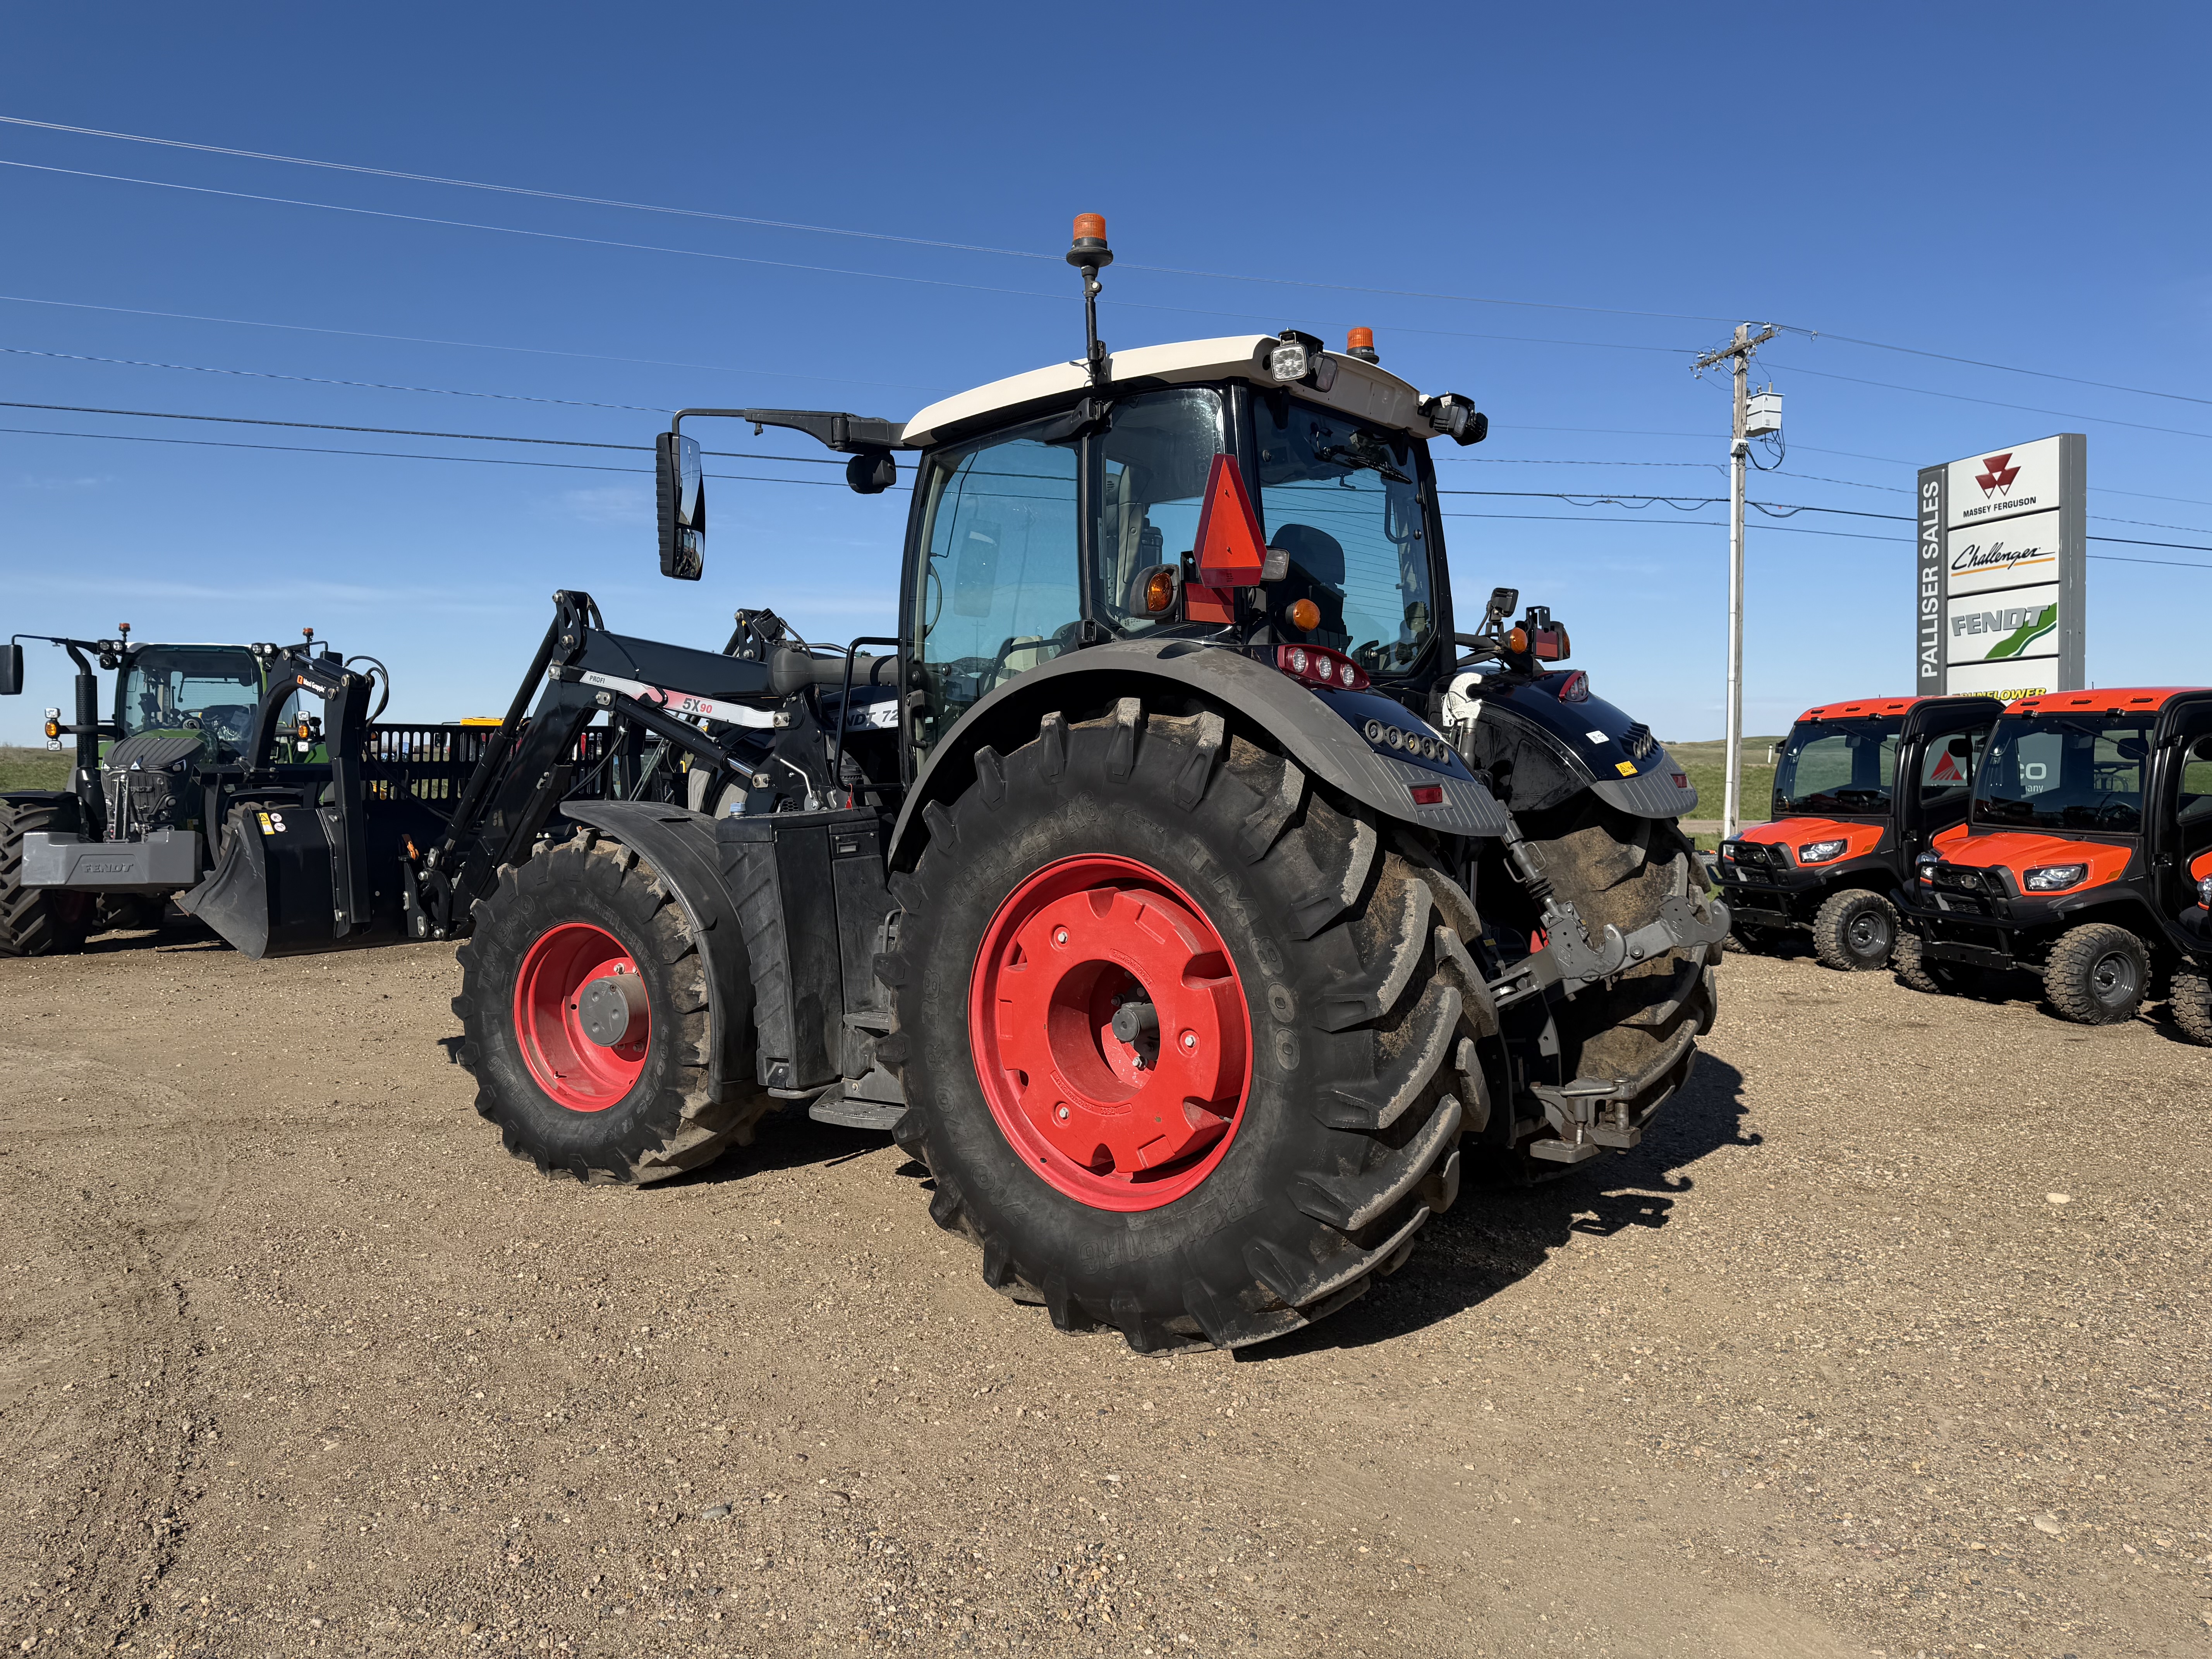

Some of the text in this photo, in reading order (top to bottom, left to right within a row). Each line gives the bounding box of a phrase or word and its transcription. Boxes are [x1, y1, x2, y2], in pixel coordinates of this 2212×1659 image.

[1963, 496, 2037, 518] MASSEY FERGUSON
[1951, 541, 2056, 570] Challenger
[1921, 481, 1939, 678] PALLISER SALES
[1951, 605, 2050, 636] FENDT
[589, 675, 605, 684] PROFI
[847, 711, 876, 726] NDT
[941, 790, 1101, 906] TRELLEBORG
[81, 864, 134, 873] FENDT
[586, 887, 660, 976] TRELLEBORG
